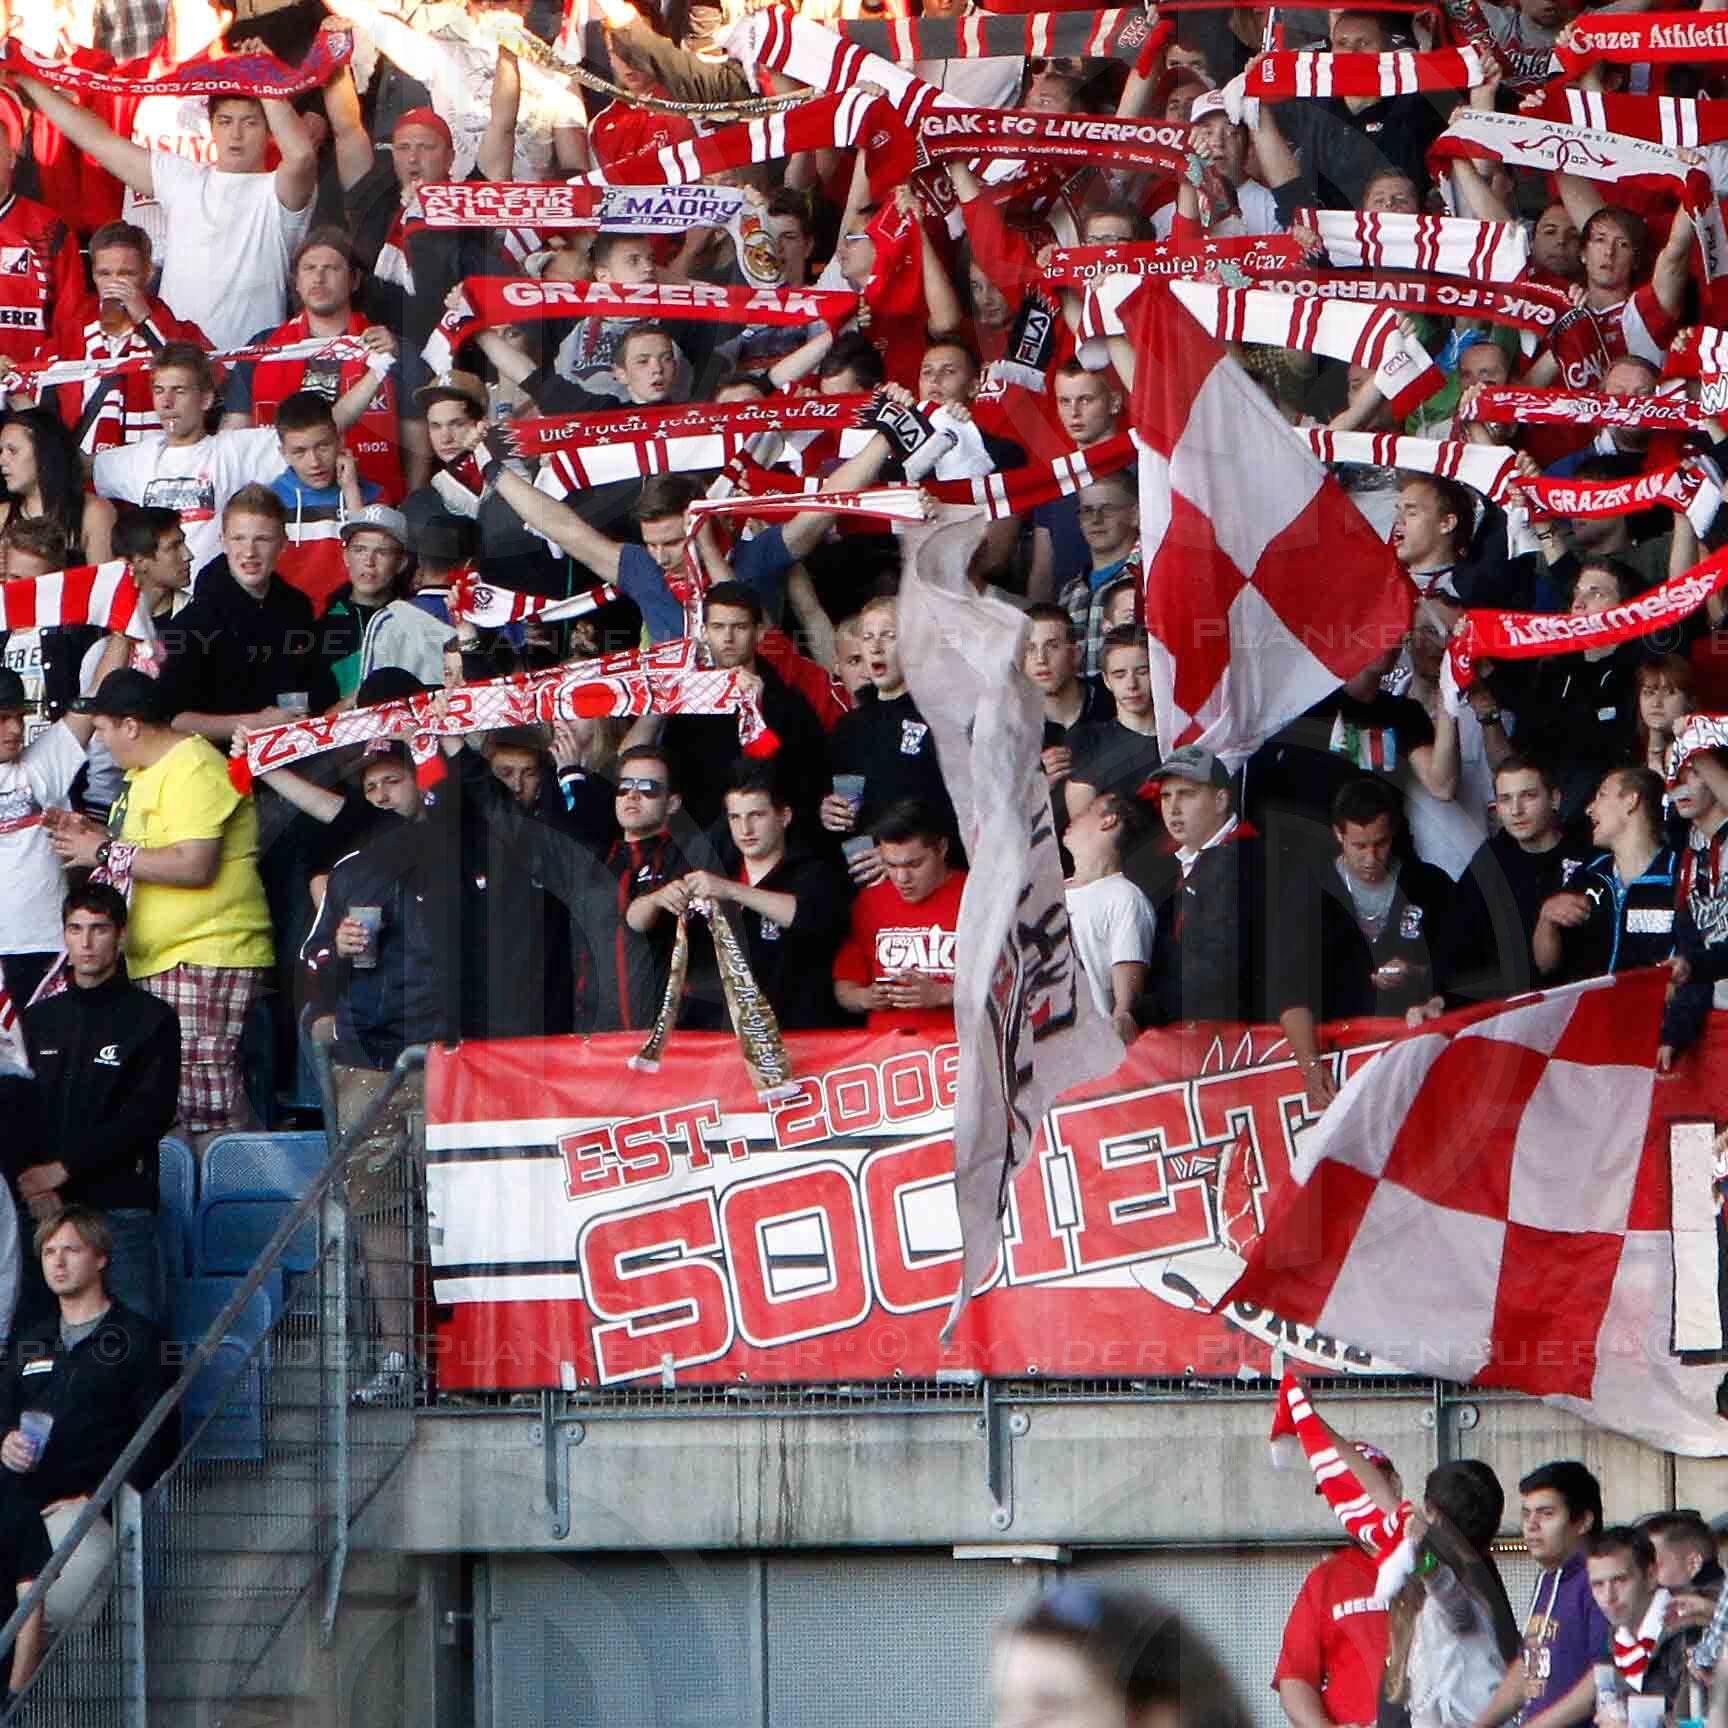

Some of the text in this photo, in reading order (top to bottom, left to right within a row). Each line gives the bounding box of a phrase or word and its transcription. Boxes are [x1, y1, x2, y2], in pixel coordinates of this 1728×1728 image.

[1570, 29, 1644, 54] Grazer
[922, 116, 1188, 150] GAK FC LIVERPOOL
[1244, 251, 1286, 270] Graz
[503, 280, 822, 318] GRAZER AK
[1436, 284, 1472, 304] FC
[1496, 296, 1558, 328] GAK
[1548, 481, 1632, 512] GRAZER
[876, 924, 960, 970] GAK
[558, 1097, 751, 1200] EST.
[576, 1037, 1392, 1384] SOCIET
